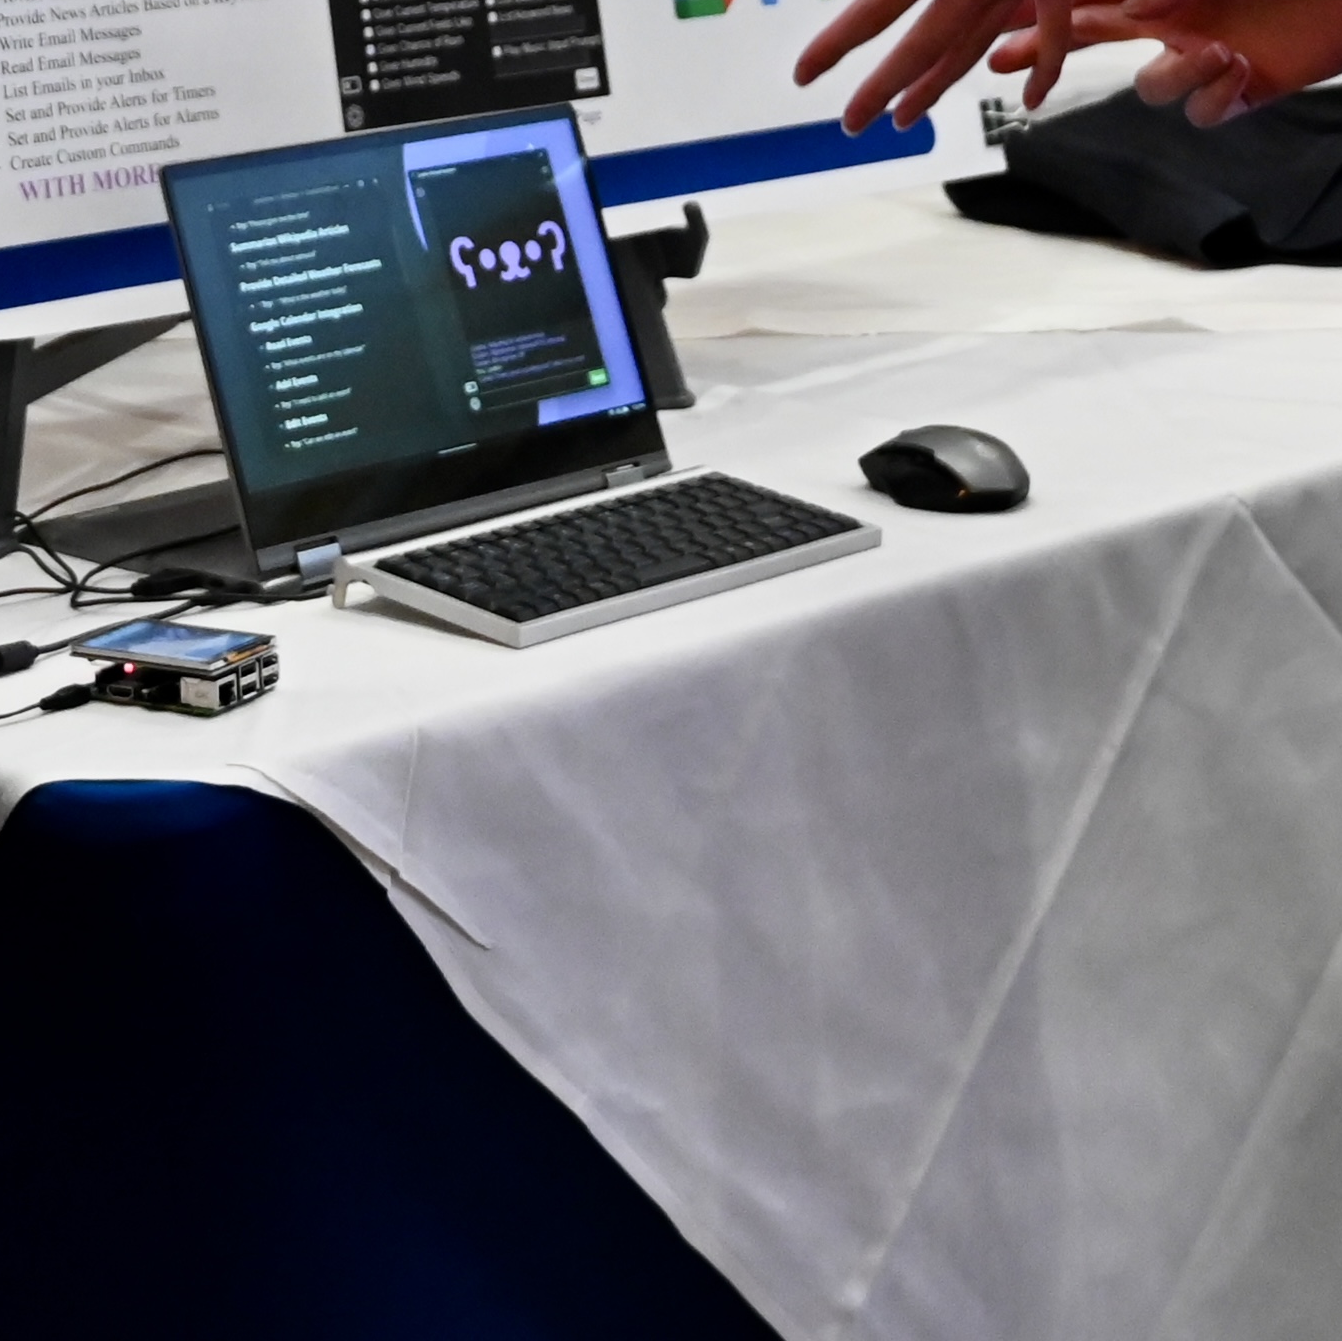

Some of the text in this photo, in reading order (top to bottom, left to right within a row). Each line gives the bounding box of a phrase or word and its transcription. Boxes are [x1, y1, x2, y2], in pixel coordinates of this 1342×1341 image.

[50, 7, 86, 22] News
[90, 0, 140, 17] Articles
[38, 29, 76, 46] Email
[80, 24, 142, 42] Messages
[1, 48, 141, 76] Read Email Messages
[3, 68, 165, 100] List Emails in your Inbox
[6, 85, 216, 123] Set and Provide Alerts for Timers
[8, 108, 219, 147] Set and Provide Alerts for Alarms
[10, 135, 180, 171] Create Custom Commands
[19, 173, 85, 201] WITH
